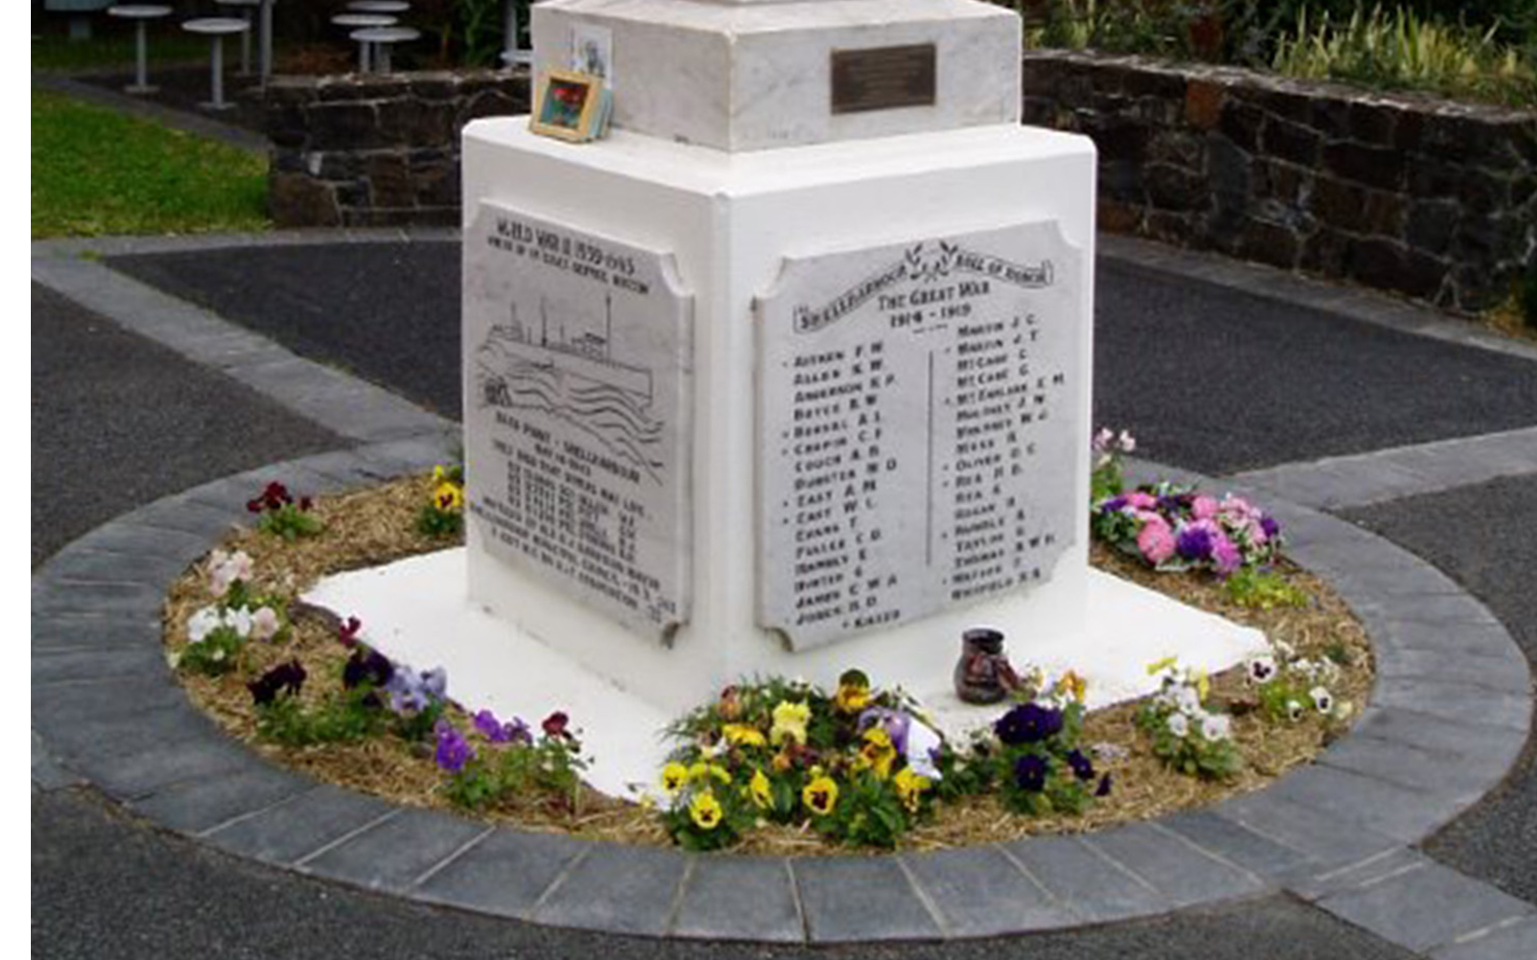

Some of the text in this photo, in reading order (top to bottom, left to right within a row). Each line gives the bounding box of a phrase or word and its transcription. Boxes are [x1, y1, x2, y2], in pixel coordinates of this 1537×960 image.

[879, 282, 989, 310] THE GREAT WAR
[941, 304, 971, 318] 1919
